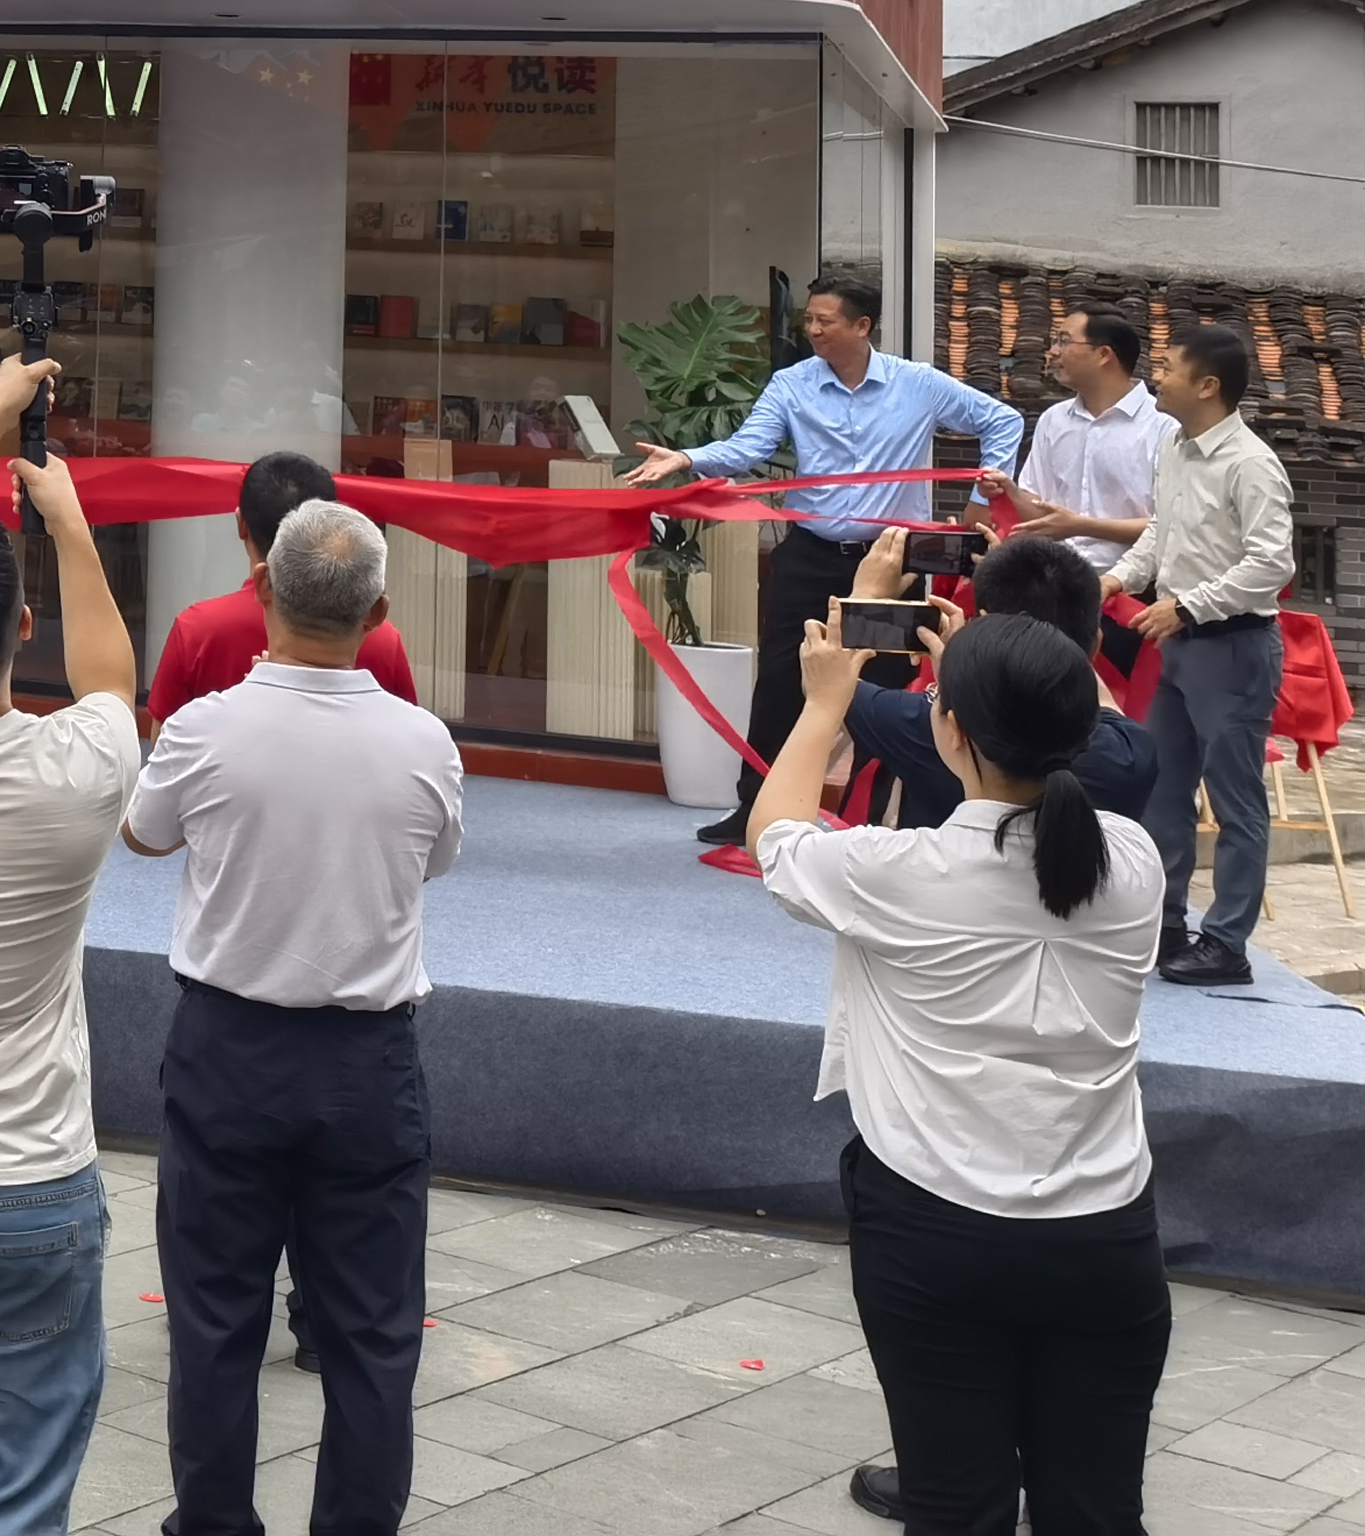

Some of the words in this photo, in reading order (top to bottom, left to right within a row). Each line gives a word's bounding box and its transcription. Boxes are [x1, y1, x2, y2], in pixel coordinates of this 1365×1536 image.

[415, 100, 477, 113] XINHUA
[485, 101, 537, 114] YUEDU
[543, 102, 596, 115] SPACE
